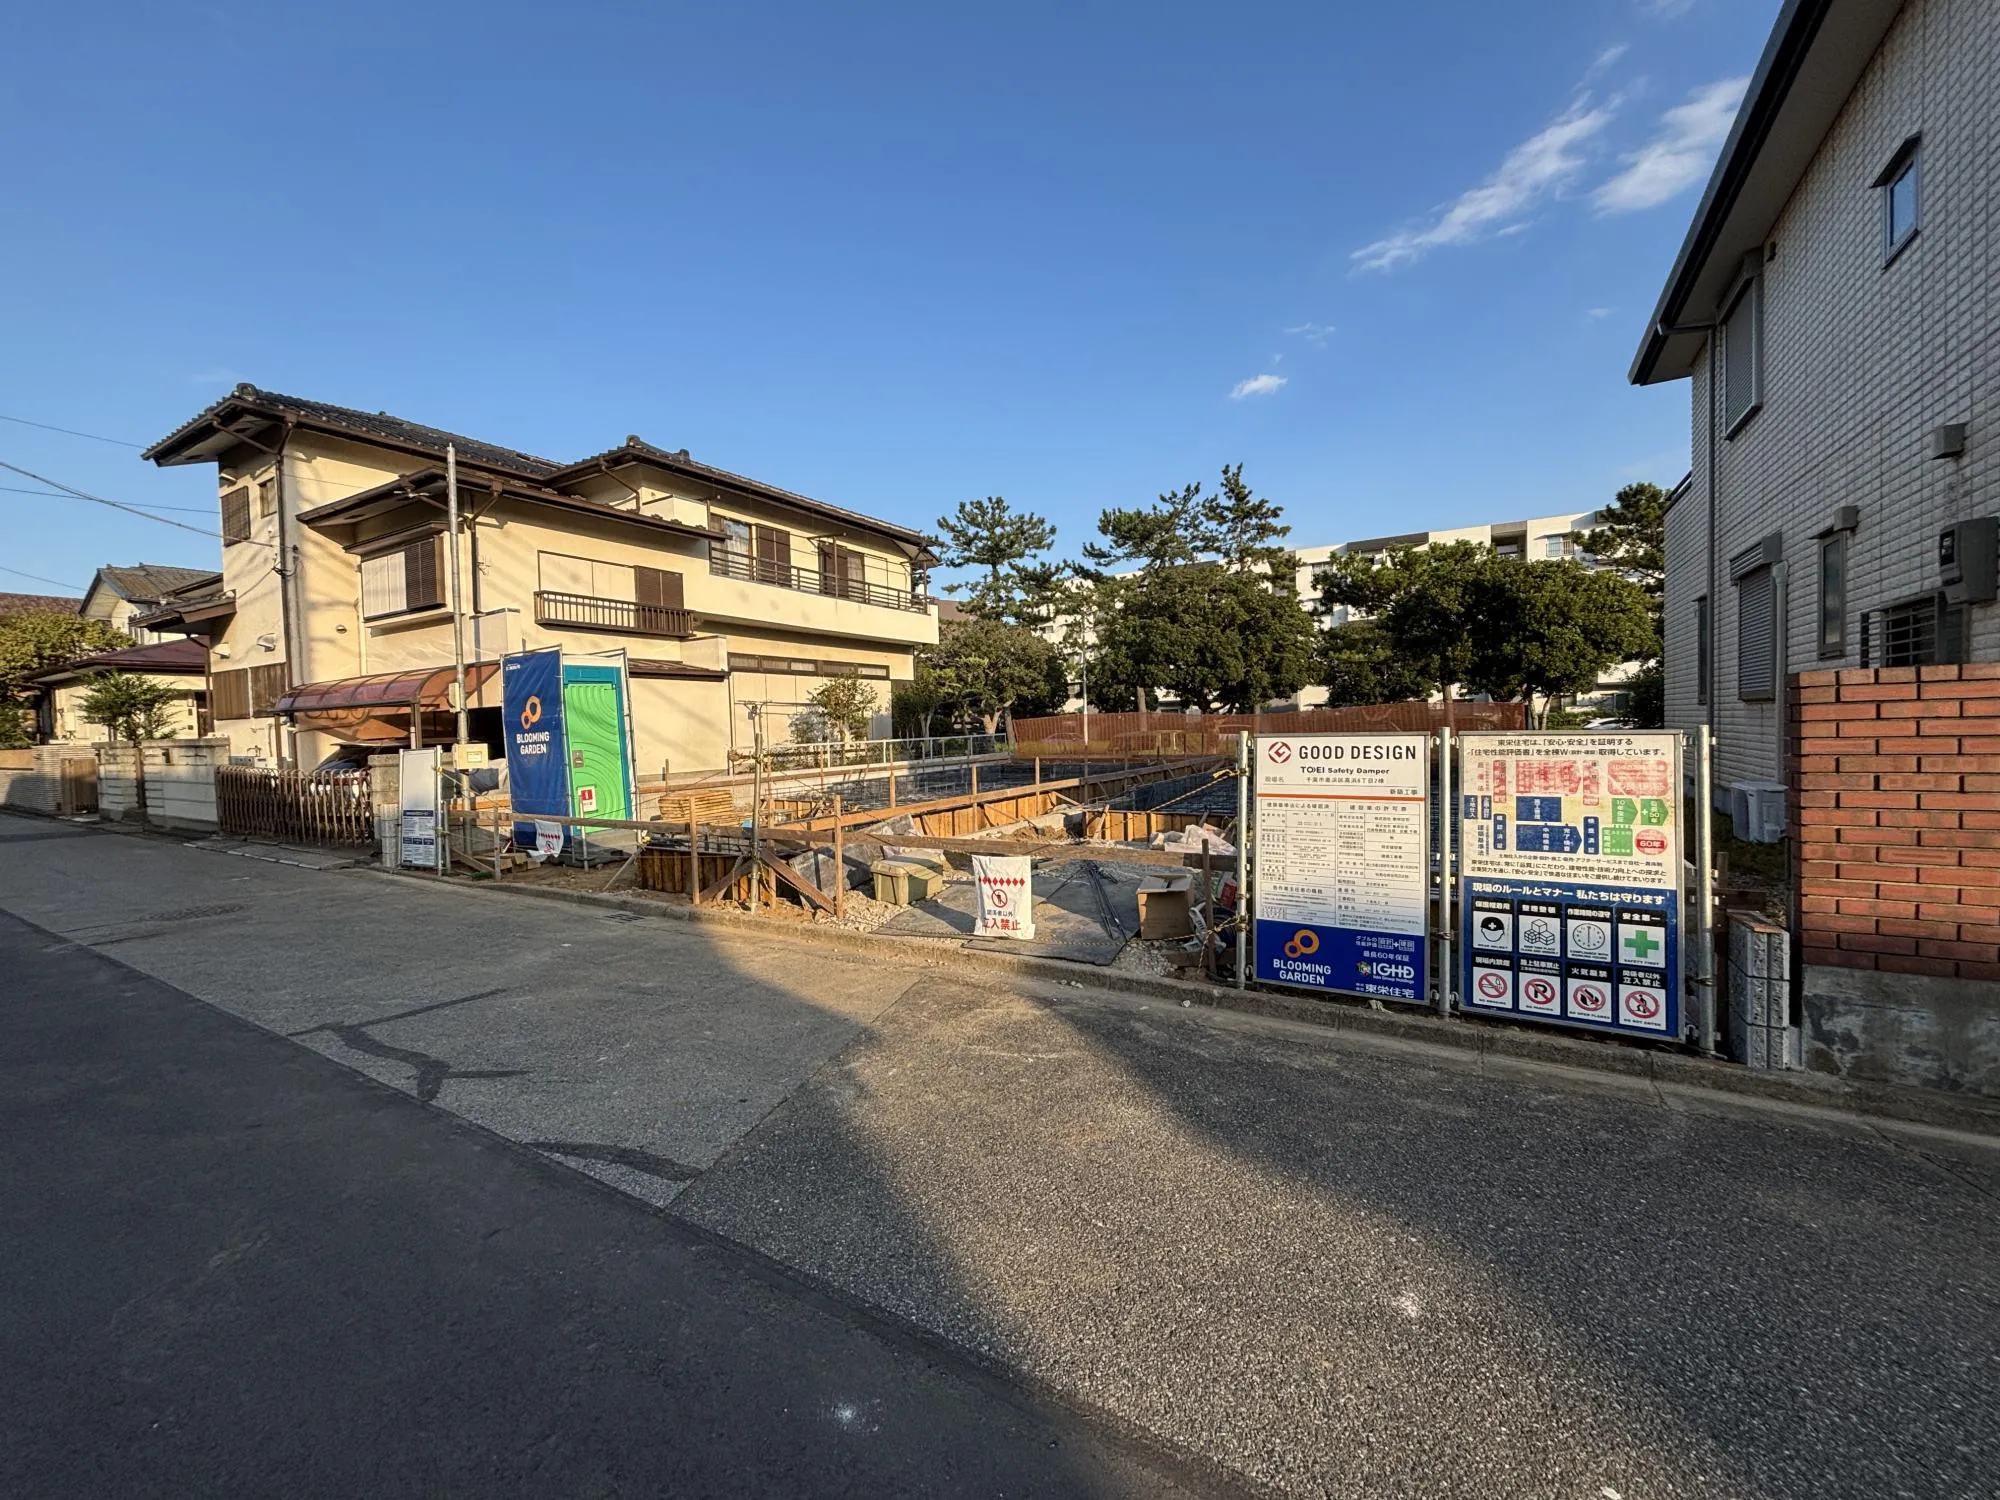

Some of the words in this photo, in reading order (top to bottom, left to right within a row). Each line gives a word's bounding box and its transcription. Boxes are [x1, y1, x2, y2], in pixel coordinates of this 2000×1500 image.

[516, 732, 549, 743] BLOOMING
[520, 744, 546, 754] GARDEN
[1300, 746, 1344, 760] GOOD
[1351, 746, 1416, 760] DESIGN
[1472, 883, 1573, 897] 現場のルールとマナー
[1576, 889, 1665, 904] 私たちは守ります
[1622, 913, 1660, 922] 安全第一
[1273, 959, 1331, 975] BLOOMING
[1280, 970, 1324, 984] GARDEN
[1623, 977, 1661, 987] 立入禁止
[1365, 984, 1414, 998] 東栄住宅
